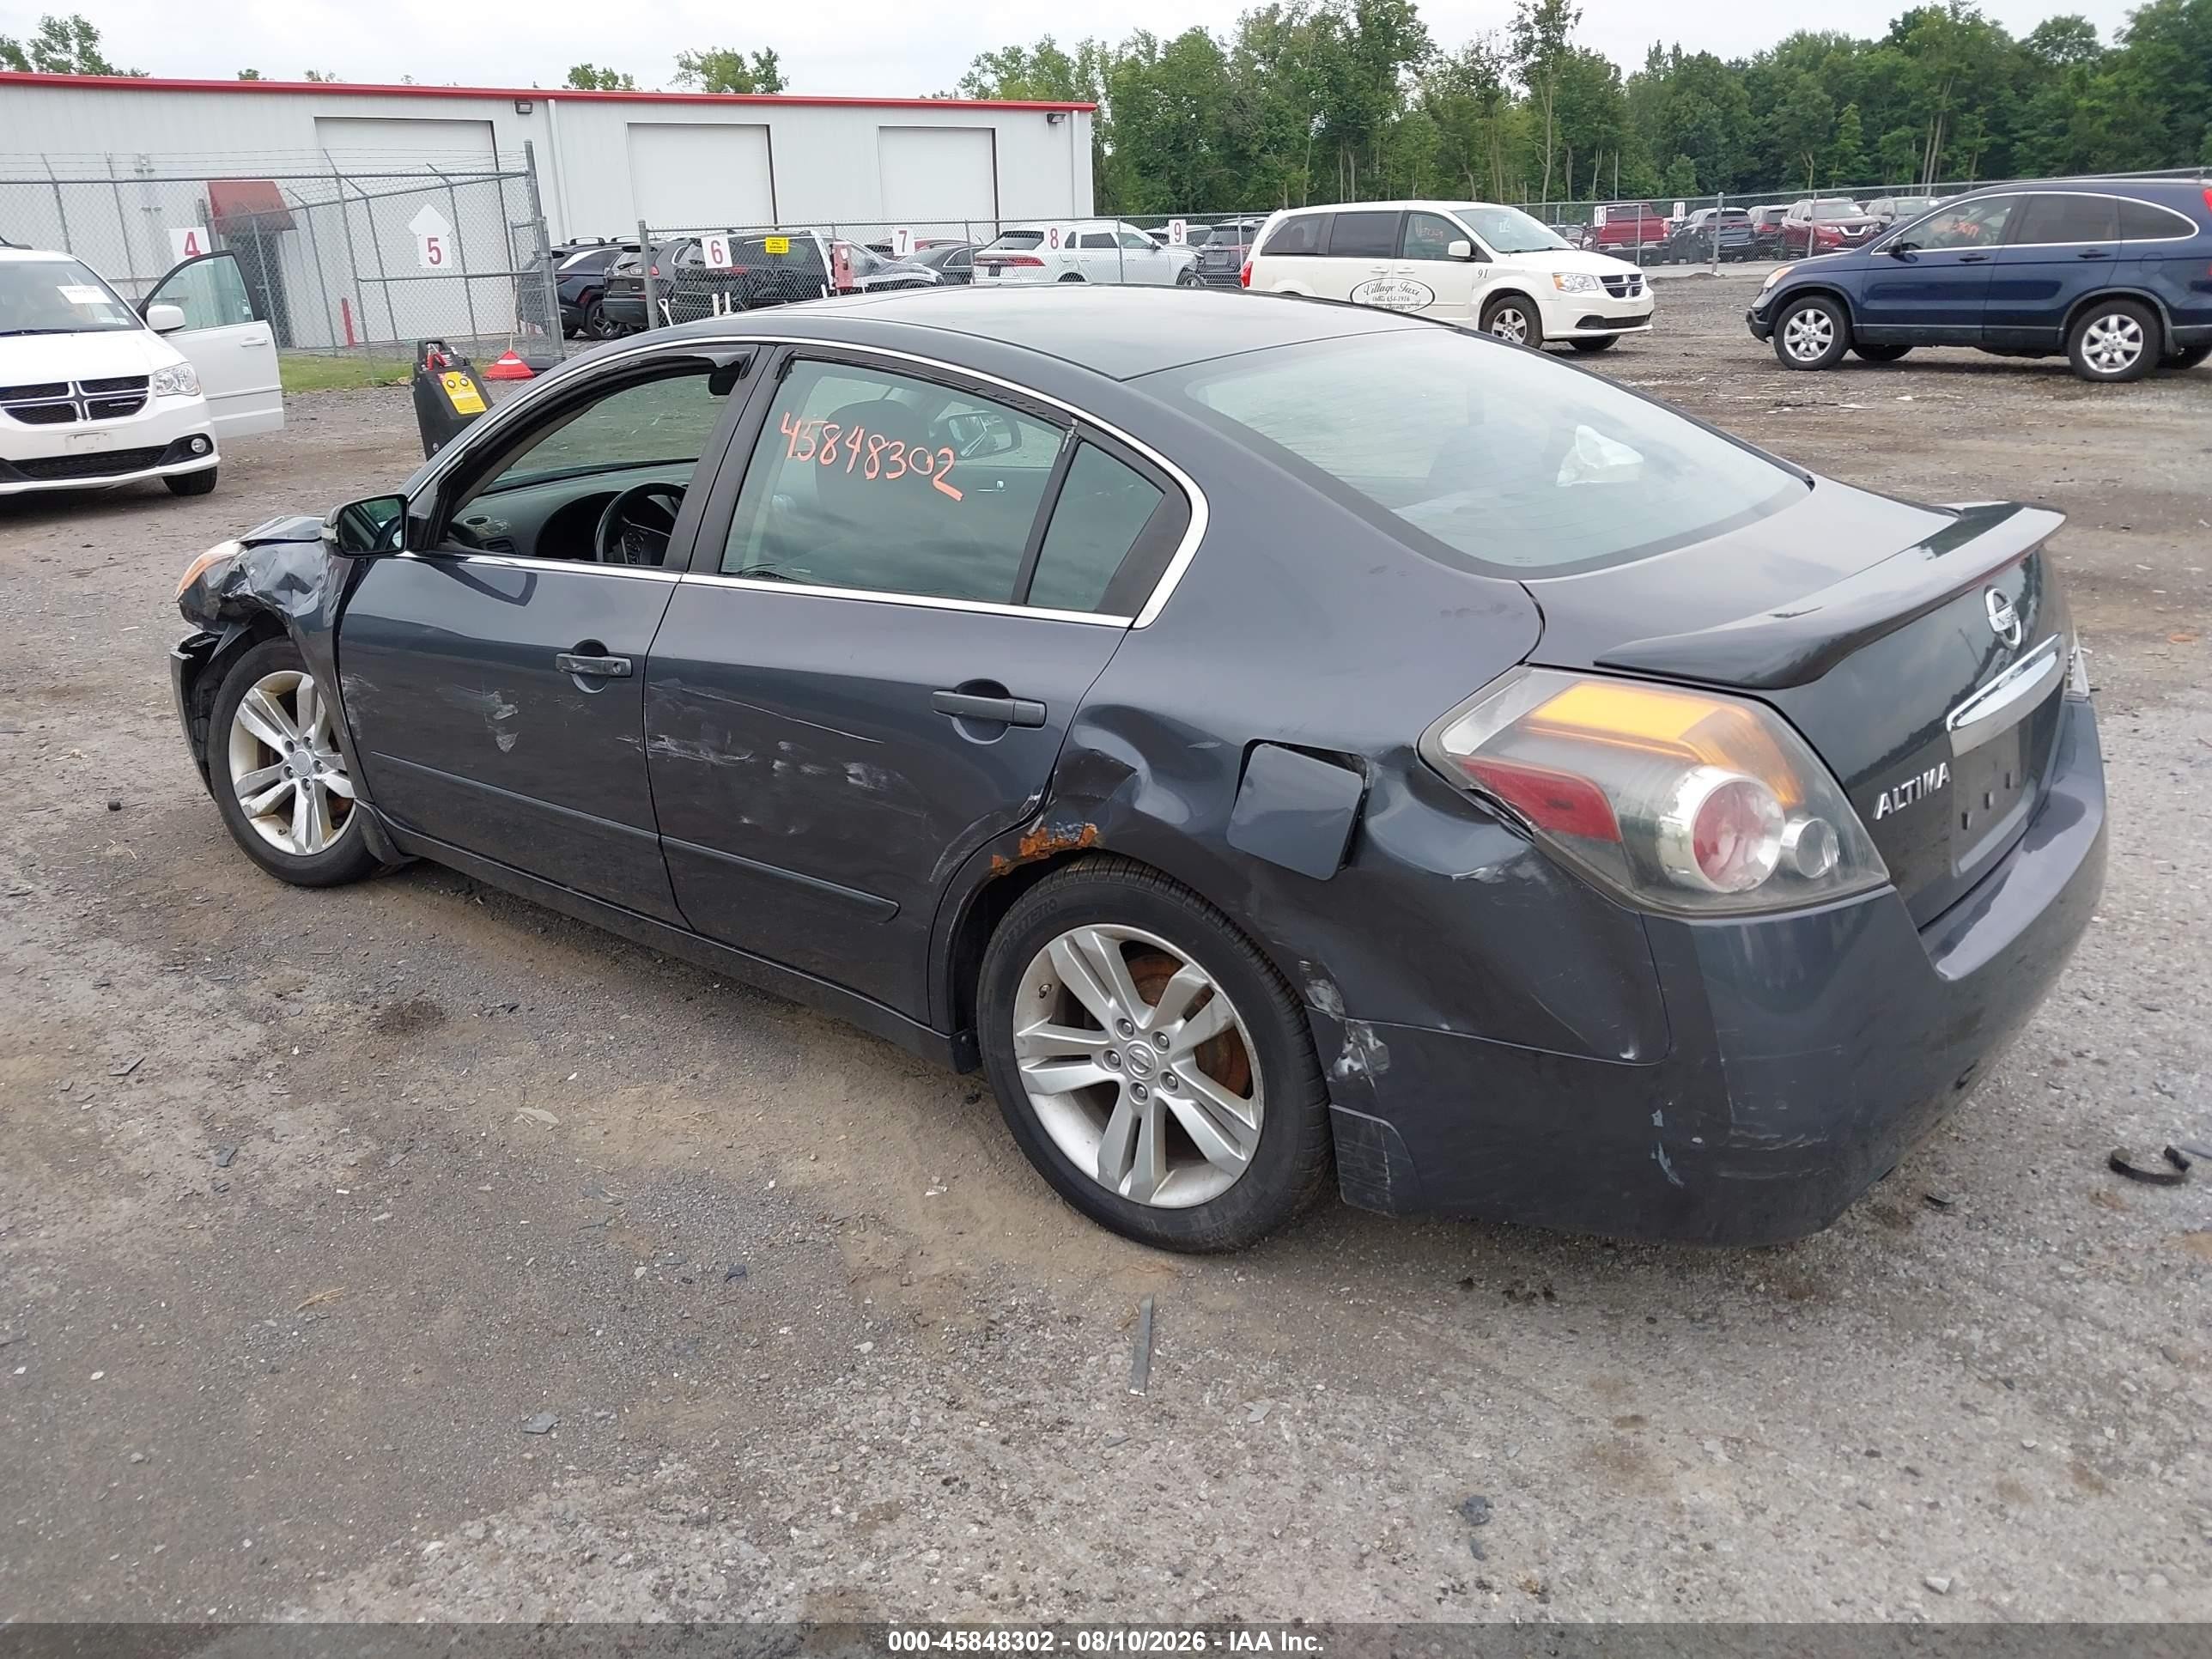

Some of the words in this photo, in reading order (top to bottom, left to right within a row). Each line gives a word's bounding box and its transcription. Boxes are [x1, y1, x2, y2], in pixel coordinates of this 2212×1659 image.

[1595, 207, 1606, 224] 13
[185, 231, 201, 256] 4
[898, 229, 908, 252] 7
[1049, 228, 1059, 250] 8
[1174, 222, 1182, 243] 9
[427, 237, 441, 265] 5
[710, 240, 723, 264] 6
[1364, 282, 1395, 295] Village
[1398, 281, 1423, 296] Taxi
[779, 411, 965, 502] 45848302
[1872, 762, 1951, 820] ALTIMA
